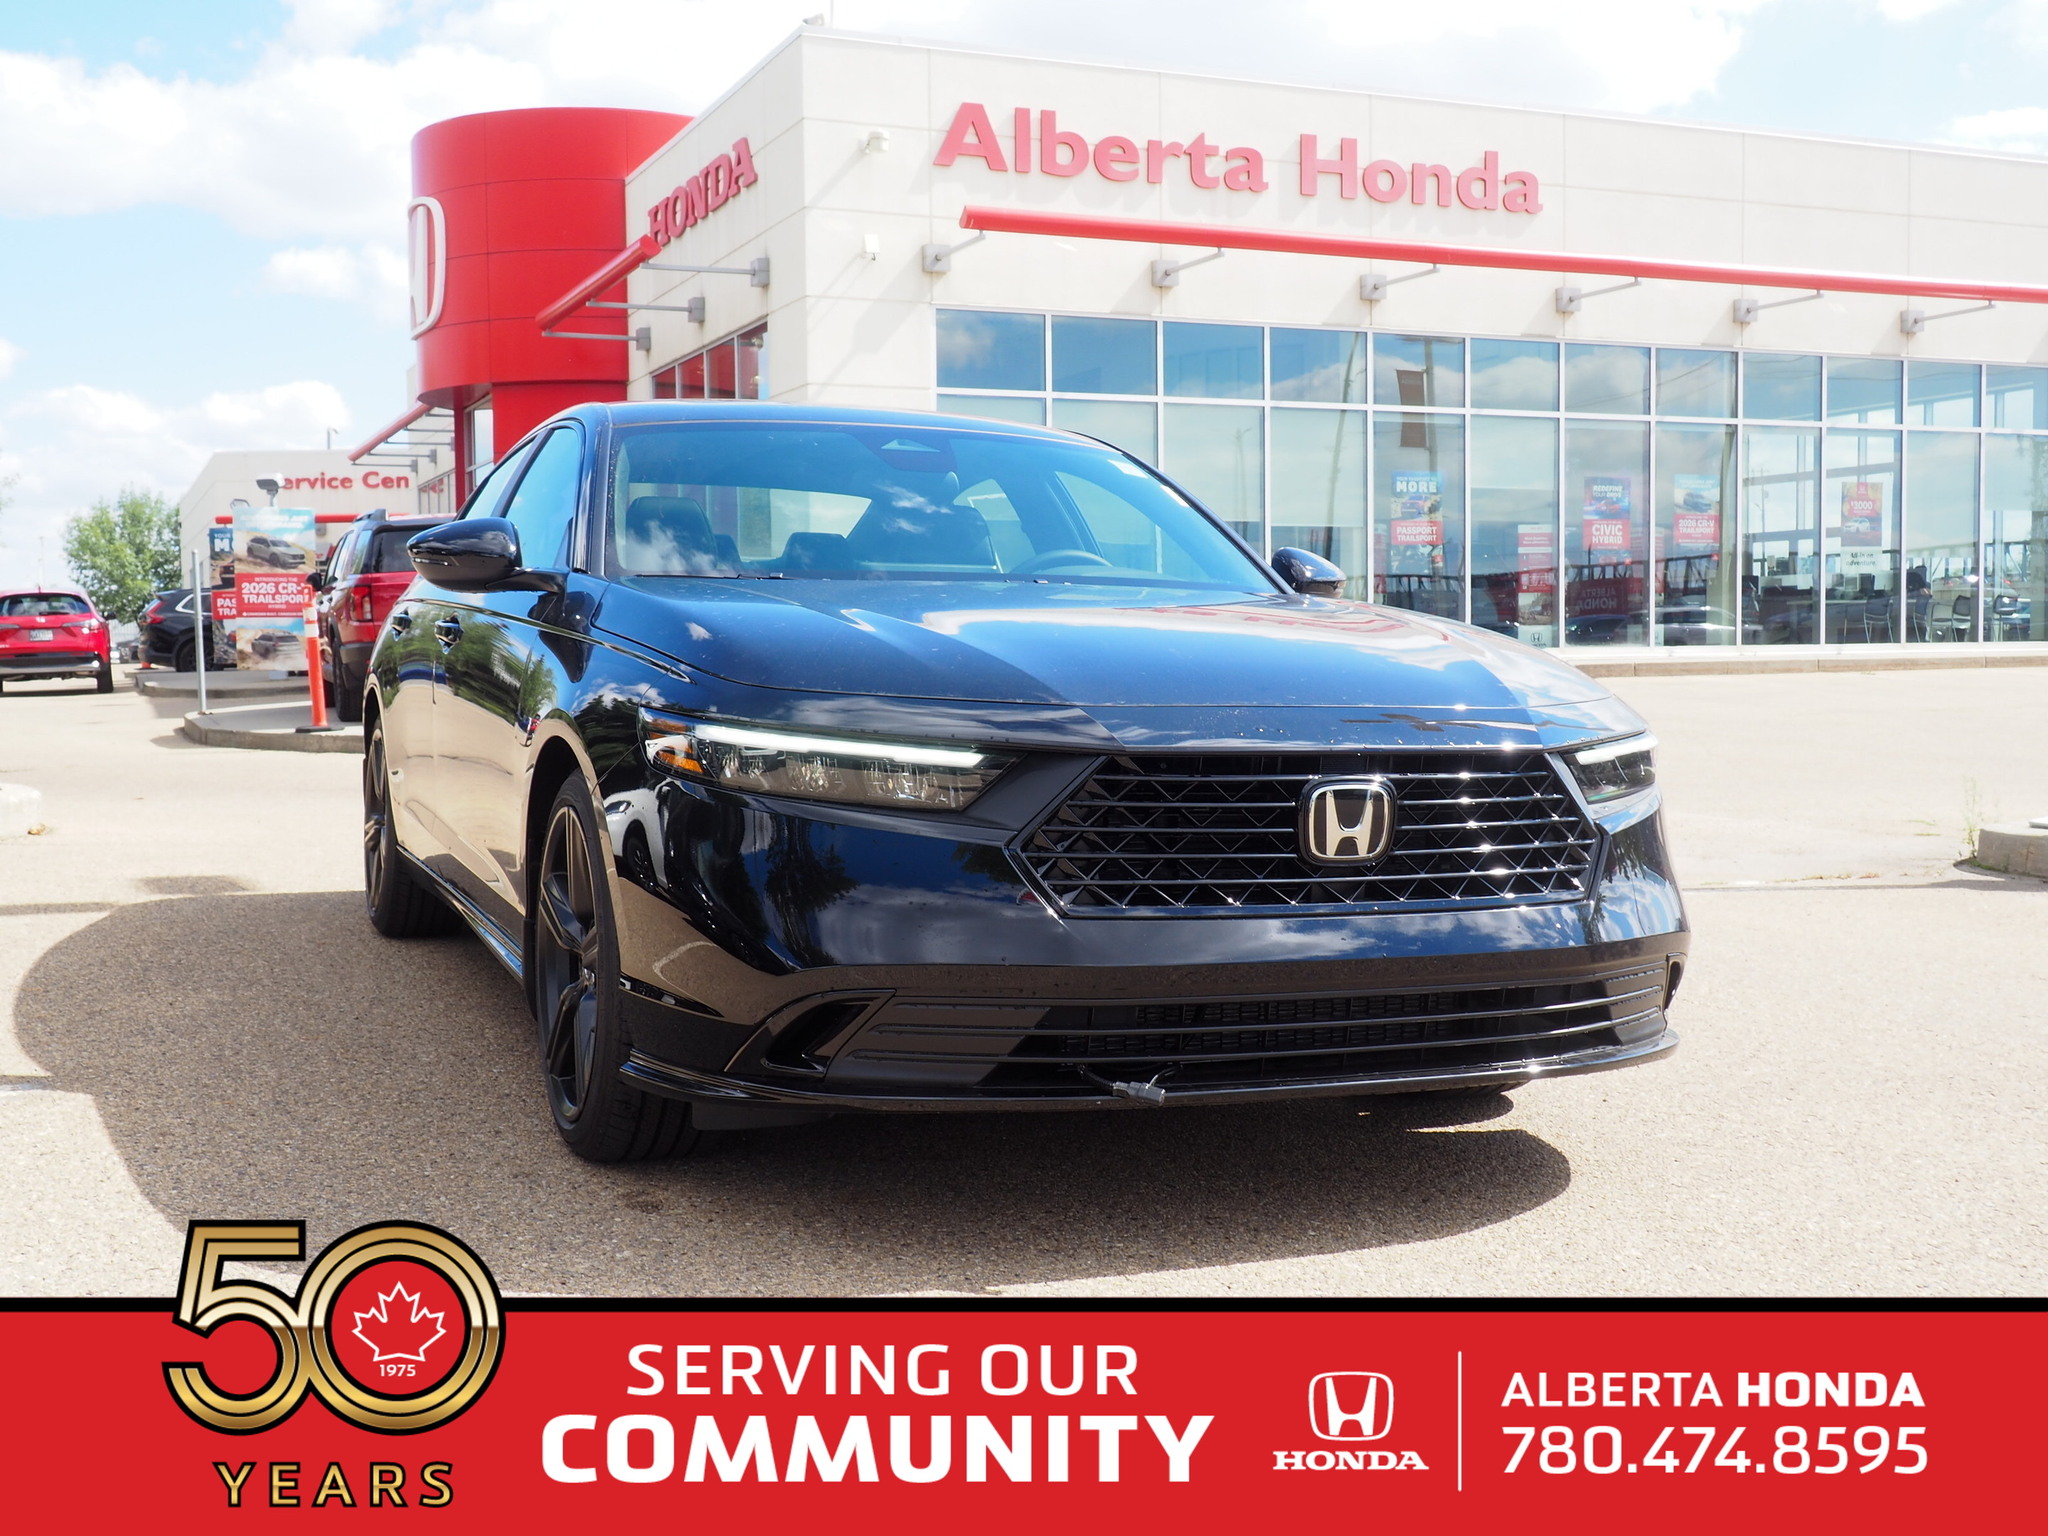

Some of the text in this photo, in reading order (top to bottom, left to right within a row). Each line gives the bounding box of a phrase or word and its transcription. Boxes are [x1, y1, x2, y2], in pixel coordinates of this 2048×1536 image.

[934, 101, 1544, 215] Alberta Honda
[648, 137, 758, 248] HONDA
[282, 472, 353, 491] ervice
[1396, 480, 1437, 493] MORE
[1396, 526, 1438, 535] PASSPORT
[1592, 524, 1623, 535] CIVIC
[1592, 536, 1623, 544] HYBRID
[241, 582, 276, 594] 2026
